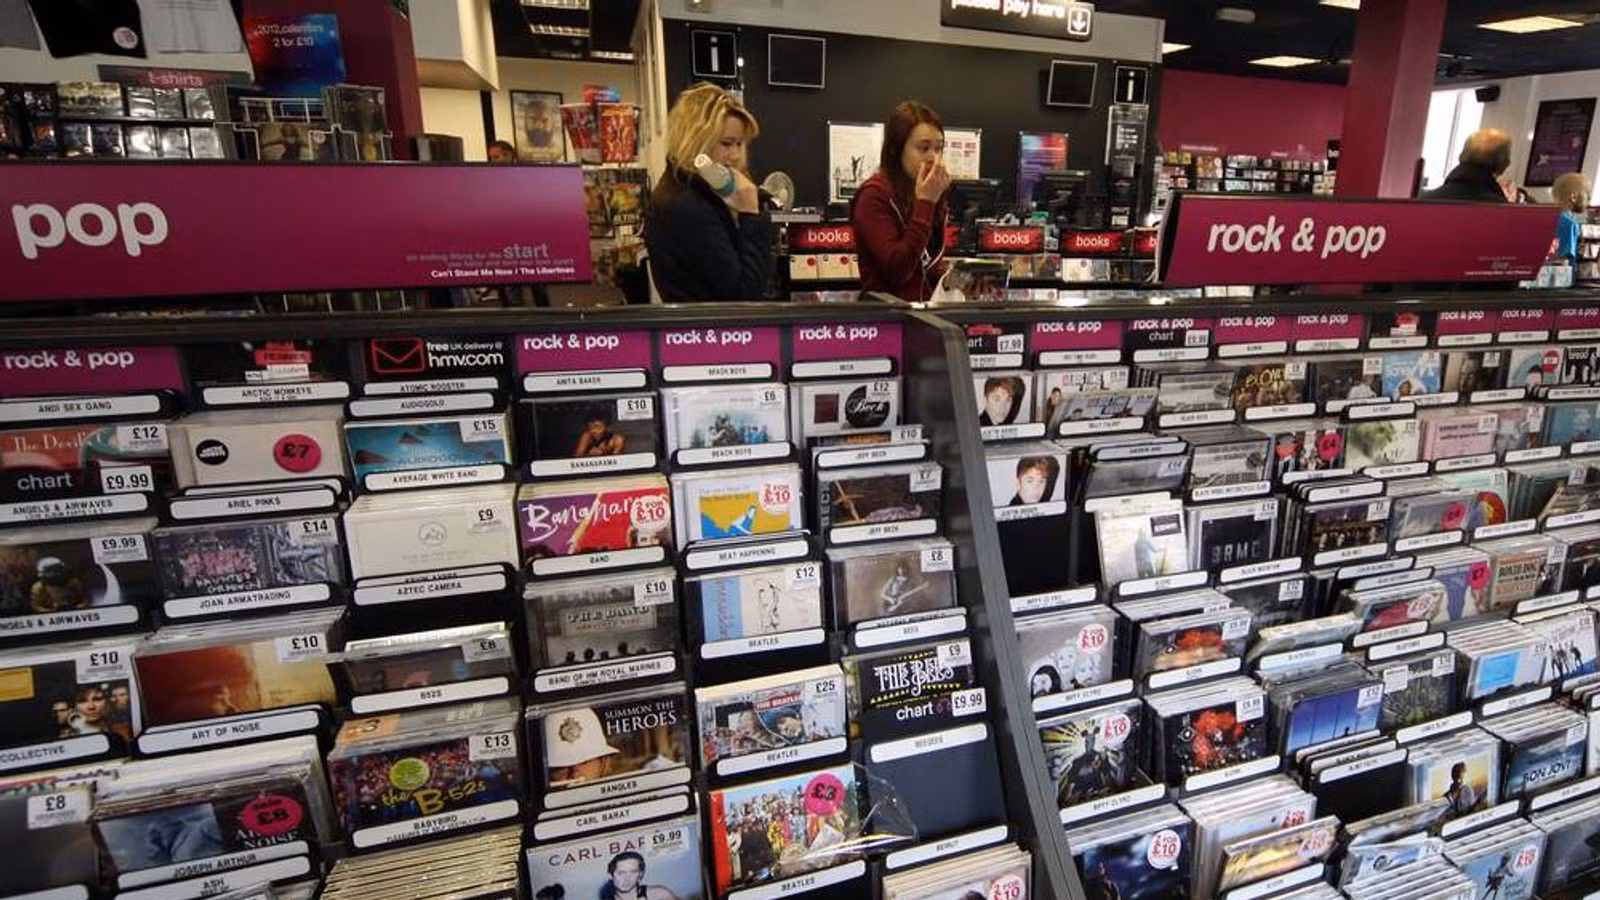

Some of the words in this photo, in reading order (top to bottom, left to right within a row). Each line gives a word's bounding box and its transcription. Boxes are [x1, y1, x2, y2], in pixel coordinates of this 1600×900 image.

[273, 37, 281, 47] 2
[148, 70, 203, 88] t-shirts
[12, 202, 168, 260] pop
[807, 229, 850, 244] books
[993, 230, 1031, 245] books
[1207, 215, 1284, 252] rock
[1291, 217, 1315, 253] &
[1321, 224, 1386, 259] pop
[1075, 234, 1110, 248] books
[503, 243, 549, 259] start
[431, 268, 453, 278] Can't
[455, 268, 479, 277] Stand
[480, 267, 494, 276] Me
[521, 267, 535, 275] The
[536, 266, 575, 275] Libertines
[1220, 317, 1243, 327] rock
[1245, 317, 1253, 326] &
[1255, 316, 1276, 327] pop
[1298, 315, 1318, 325] rock
[1330, 313, 1348, 326] pop
[1440, 312, 1458, 320] rock
[1468, 310, 1485, 321] pop
[1037, 322, 1064, 333] rock
[1066, 322, 1076, 332] &
[1078, 320, 1102, 334] pop
[1133, 319, 1159, 331] rock
[1161, 319, 1170, 329] &
[1172, 318, 1194, 330] pop
[665, 329, 701, 345] rock
[705, 329, 718, 343] &
[721, 330, 752, 344] pop
[799, 325, 831, 341] rock
[835, 325, 846, 340] &
[849, 325, 878, 341] pop
[1149, 331, 1174, 341] chart
[426, 342, 449, 351] free
[464, 342, 494, 351] delivery
[523, 334, 563, 350] rock
[567, 334, 581, 349] &
[585, 334, 619, 351] pop
[4, 351, 58, 369] rock
[64, 350, 83, 367] &
[88, 350, 134, 369] pop
[428, 352, 503, 368] hmv.com
[400, 384, 427, 393] ATOMIC
[431, 381, 465, 392] ROOSTER
[557, 376, 576, 386] ANITA
[579, 375, 601, 385] BAKER
[873, 382, 889, 393] £12
[242, 388, 271, 398] ARCTIC
[274, 386, 312, 397] MONKEYS
[38, 403, 61, 414] ANDI
[65, 402, 83, 413] SEX
[86, 400, 112, 412] GANG
[627, 399, 646, 410] £10
[473, 419, 496, 431] £15
[133, 426, 158, 440] £12
[900, 428, 917, 440] £10
[281, 442, 310, 459] £7
[17, 473, 75, 490] chart
[106, 473, 149, 490] £9.99
[393, 473, 429, 484] AVERAGE
[431, 471, 455, 481] WHITE
[457, 470, 477, 479] BAND
[228, 499, 253, 510] ARIEL
[256, 496, 281, 508] PINKS
[644, 501, 663, 509] FOR
[763, 492, 791, 504] £10
[12, 504, 51, 516] ANGELS
[65, 500, 113, 513] AIRWAVES
[478, 508, 494, 521] £9
[636, 507, 665, 521] £10
[303, 519, 328, 533] £14
[102, 537, 137, 549] £9.99
[590, 555, 609, 564] BAND
[719, 550, 736, 561] BEAT
[739, 547, 776, 558] HAPPENING
[796, 567, 815, 579] £12
[398, 584, 425, 596] AZTEC
[427, 581, 462, 593] CAMERA
[646, 580, 667, 593] £10
[200, 598, 223, 610] JOAN
[228, 591, 291, 606] ARMATRADING
[0, 618, 35, 632] NGELS
[50, 613, 100, 626] AIRWAVES
[291, 635, 318, 649] £10
[479, 640, 496, 651] £8
[748, 637, 779, 648] BEATLES
[949, 644, 960, 656] £9
[90, 652, 118, 666] £10
[549, 675, 571, 686] BAND
[573, 674, 583, 682] OF
[585, 671, 598, 680] HM
[600, 668, 626, 679] ROYAL
[628, 661, 661, 673] MARINES
[815, 681, 836, 694] £25
[954, 693, 982, 709] £9.99
[604, 704, 652, 719] SUMMON
[656, 700, 675, 712] THE
[896, 702, 934, 721] chart
[606, 711, 677, 735] HEROES
[192, 729, 211, 741] ART
[216, 727, 228, 737] OF
[232, 723, 260, 735] NOISE
[485, 735, 510, 748] £13
[0, 745, 65, 764] COLLECTIVE
[767, 749, 799, 763] BEATLES
[1523, 768, 1547, 783] BON
[1548, 760, 1571, 777] JOVI
[600, 781, 637, 794] BANGLES
[45, 795, 66, 811] £8
[413, 814, 458, 831] BABYBIRD
[576, 814, 599, 828] CARL
[652, 829, 682, 845] £9.99
[549, 846, 603, 868] CARL
[1152, 843, 1177, 857] £10
[175, 863, 212, 880] JOSEPH
[217, 854, 257, 868] ARTHUR
[203, 878, 224, 890] ASH
[781, 876, 815, 891] BEATLES
